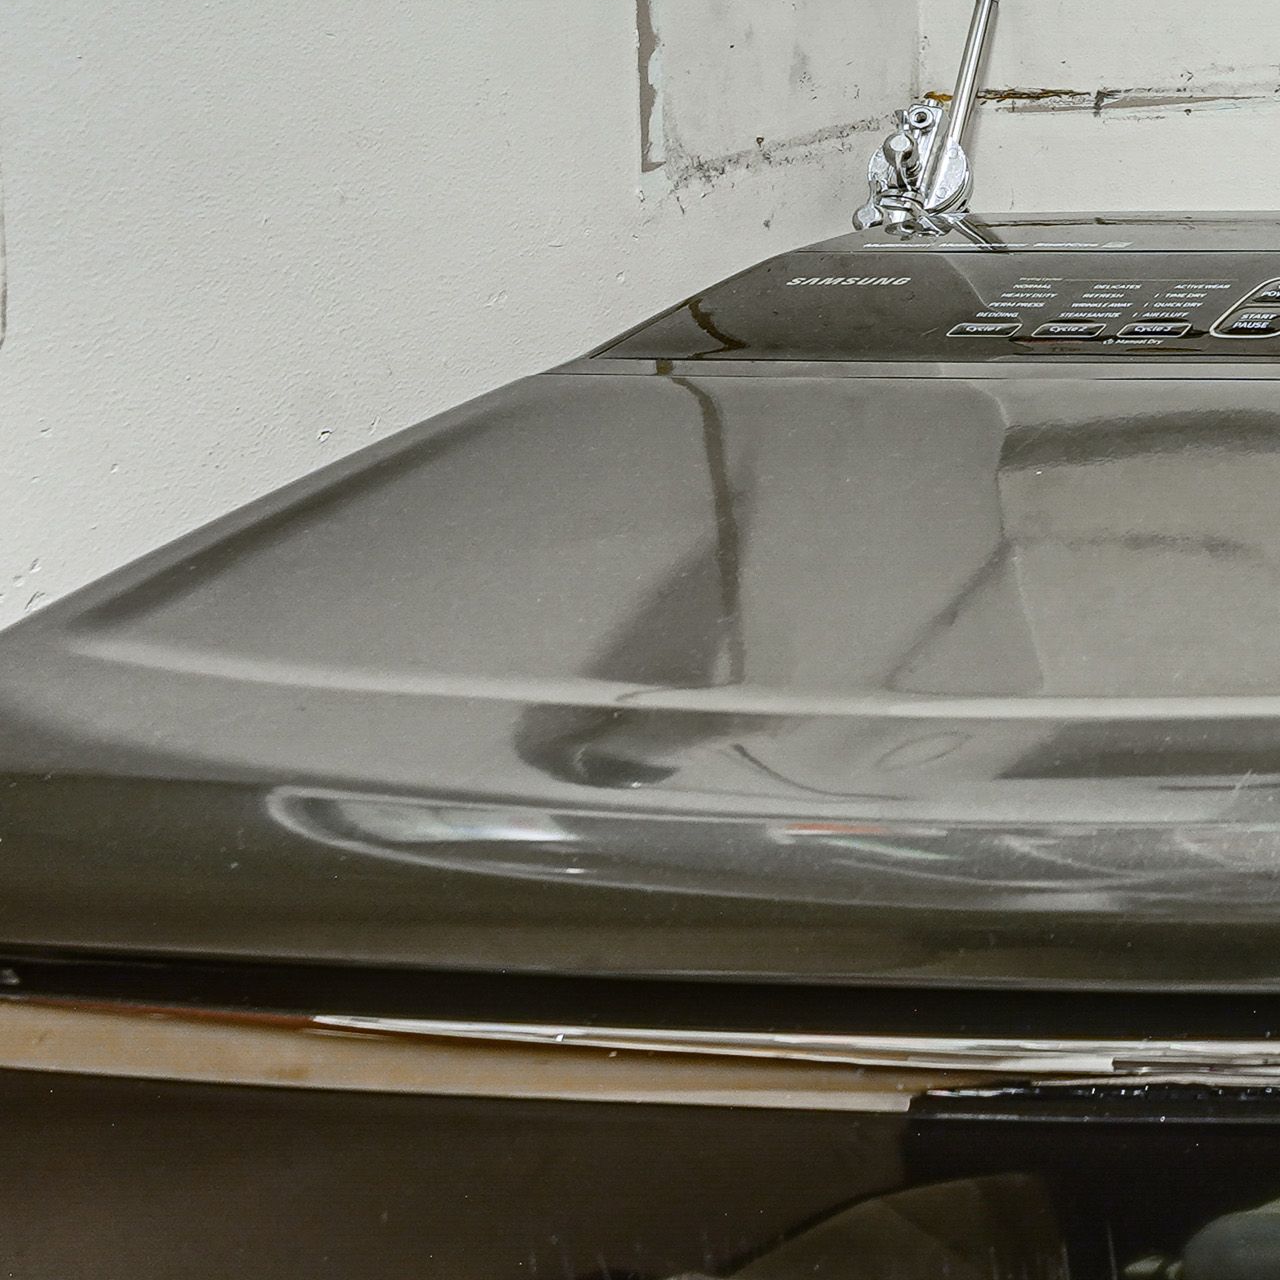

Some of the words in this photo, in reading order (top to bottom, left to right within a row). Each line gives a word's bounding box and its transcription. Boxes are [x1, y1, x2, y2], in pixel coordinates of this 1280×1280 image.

[786, 277, 911, 285] SAMSUNG
[965, 325, 995, 333] Cycle
[1049, 325, 1078, 333] Cycle
[1134, 325, 1164, 333] Cycle
